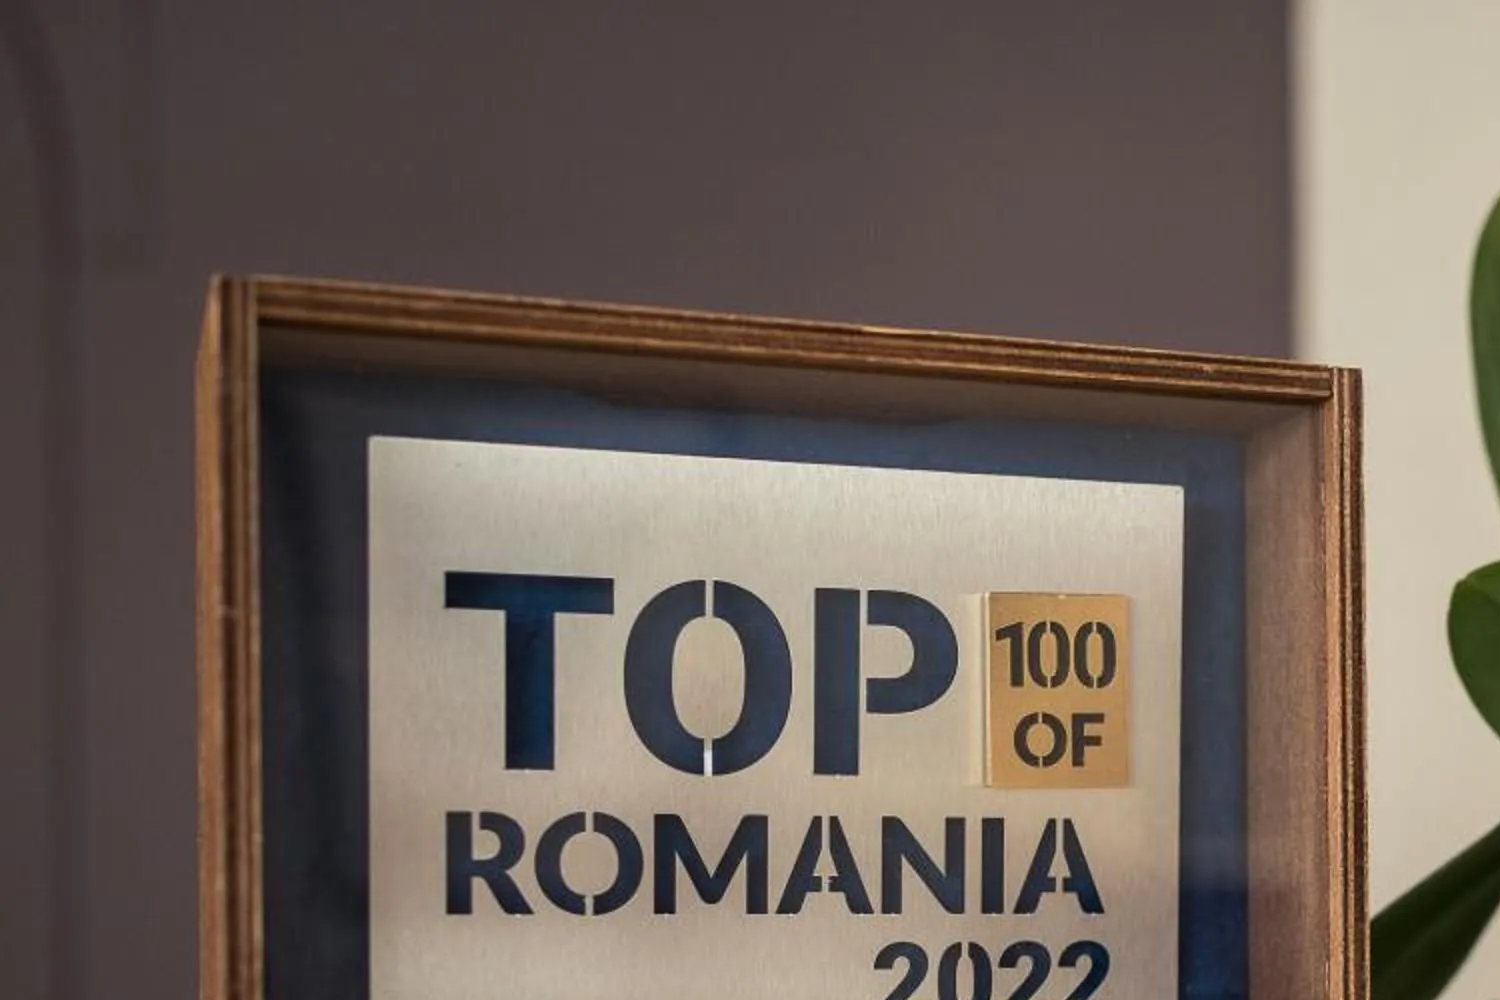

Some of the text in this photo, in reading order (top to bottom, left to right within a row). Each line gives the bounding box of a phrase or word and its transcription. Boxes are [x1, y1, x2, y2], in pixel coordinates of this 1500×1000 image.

[443, 571, 959, 777] TOP
[995, 620, 1117, 689] 100
[1012, 712, 1106, 768] OF
[445, 811, 1106, 915] ROMANIA
